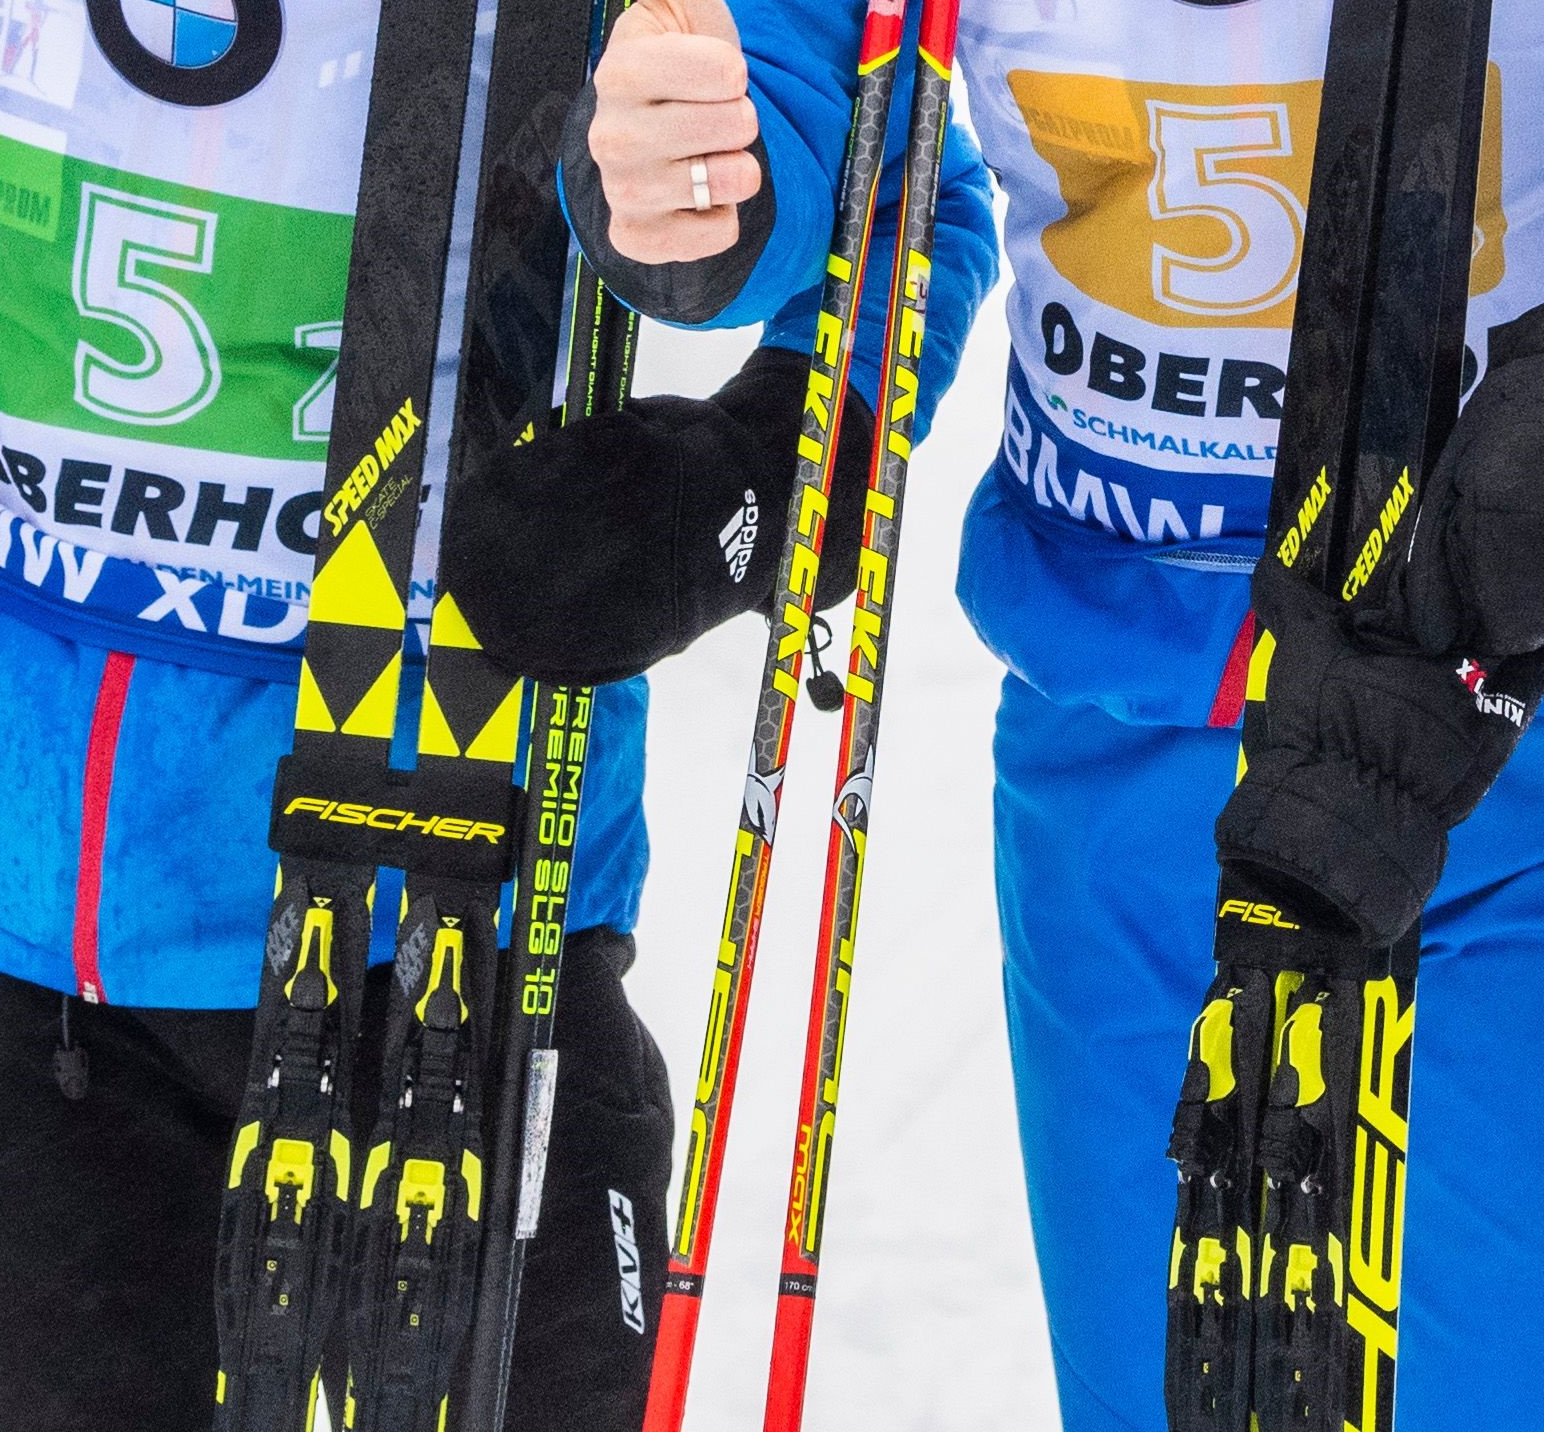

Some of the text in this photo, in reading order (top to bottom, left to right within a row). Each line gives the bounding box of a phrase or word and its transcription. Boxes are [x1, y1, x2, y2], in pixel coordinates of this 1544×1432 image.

[1149, 100, 1307, 316] 5
[72, 181, 221, 427] 5
[590, 328, 600, 369] LIGHT
[621, 334, 631, 374] LIGHT
[798, 252, 852, 465] LEKI
[1041, 301, 1288, 420] OBER
[324, 397, 422, 538] SPEED MAX
[364, 477, 397, 519] SKATE
[1006, 382, 1225, 544] BMW
[1300, 465, 1333, 537] MAX
[1381, 465, 1415, 547] MAX
[734, 487, 759, 585] adidas
[773, 485, 829, 704] LEKI
[846, 488, 896, 705] LEKI
[284, 796, 506, 845] FISCHER
[522, 686, 569, 1016] REMIO SLG 10
[543, 860, 569, 955] SLG
[536, 966, 556, 1016] 10
